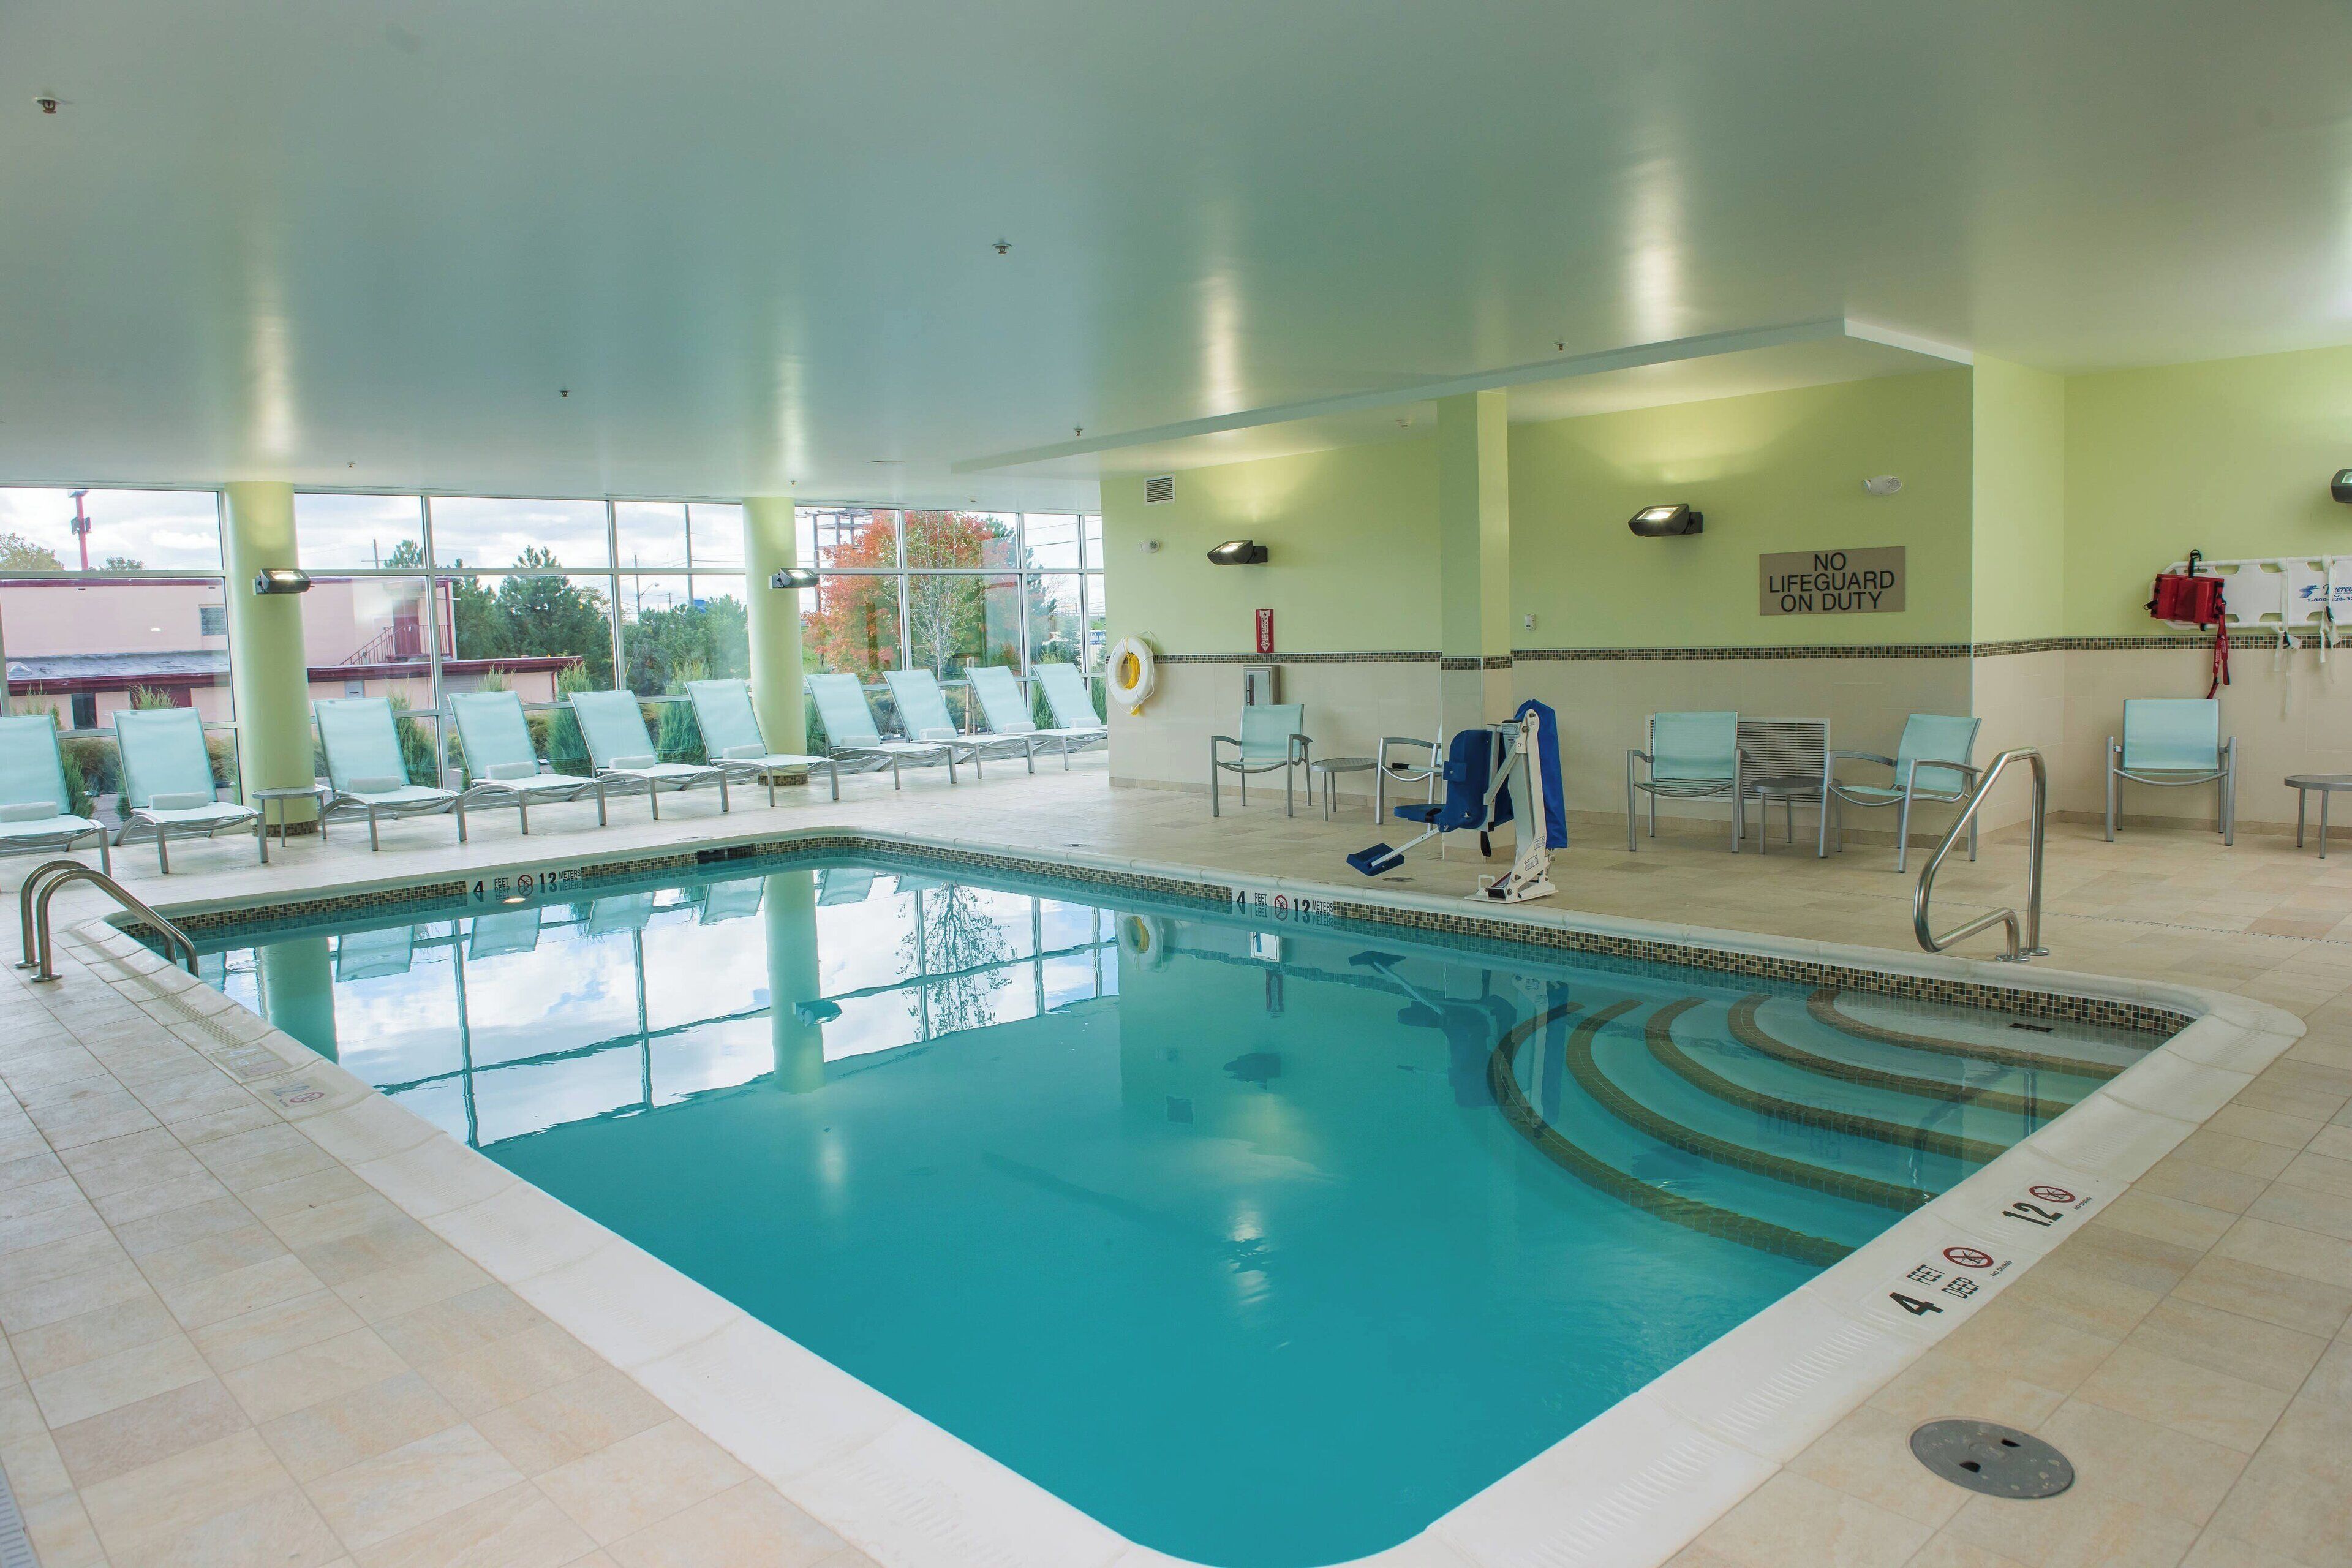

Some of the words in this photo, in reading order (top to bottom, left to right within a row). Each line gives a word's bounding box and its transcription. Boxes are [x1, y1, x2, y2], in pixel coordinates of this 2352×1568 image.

[1814, 552, 1847, 571] NO
[1769, 570, 1895, 593] LIFEGUARD
[1781, 594, 1812, 612] ON
[1822, 591, 1882, 611] DUTY
[559, 869, 581, 879] METERS
[473, 880, 484, 892] 4
[494, 877, 509, 886] FEET
[1237, 891, 1246, 903] 4
[1254, 892, 1267, 903] FEET
[1312, 900, 1333, 913] METERS
[1997, 1260, 2013, 1272] DIVING
[1906, 1264, 1945, 1286] FEET
[1941, 1276, 1980, 1299] DEEP
[1889, 1292, 1944, 1316] 4
